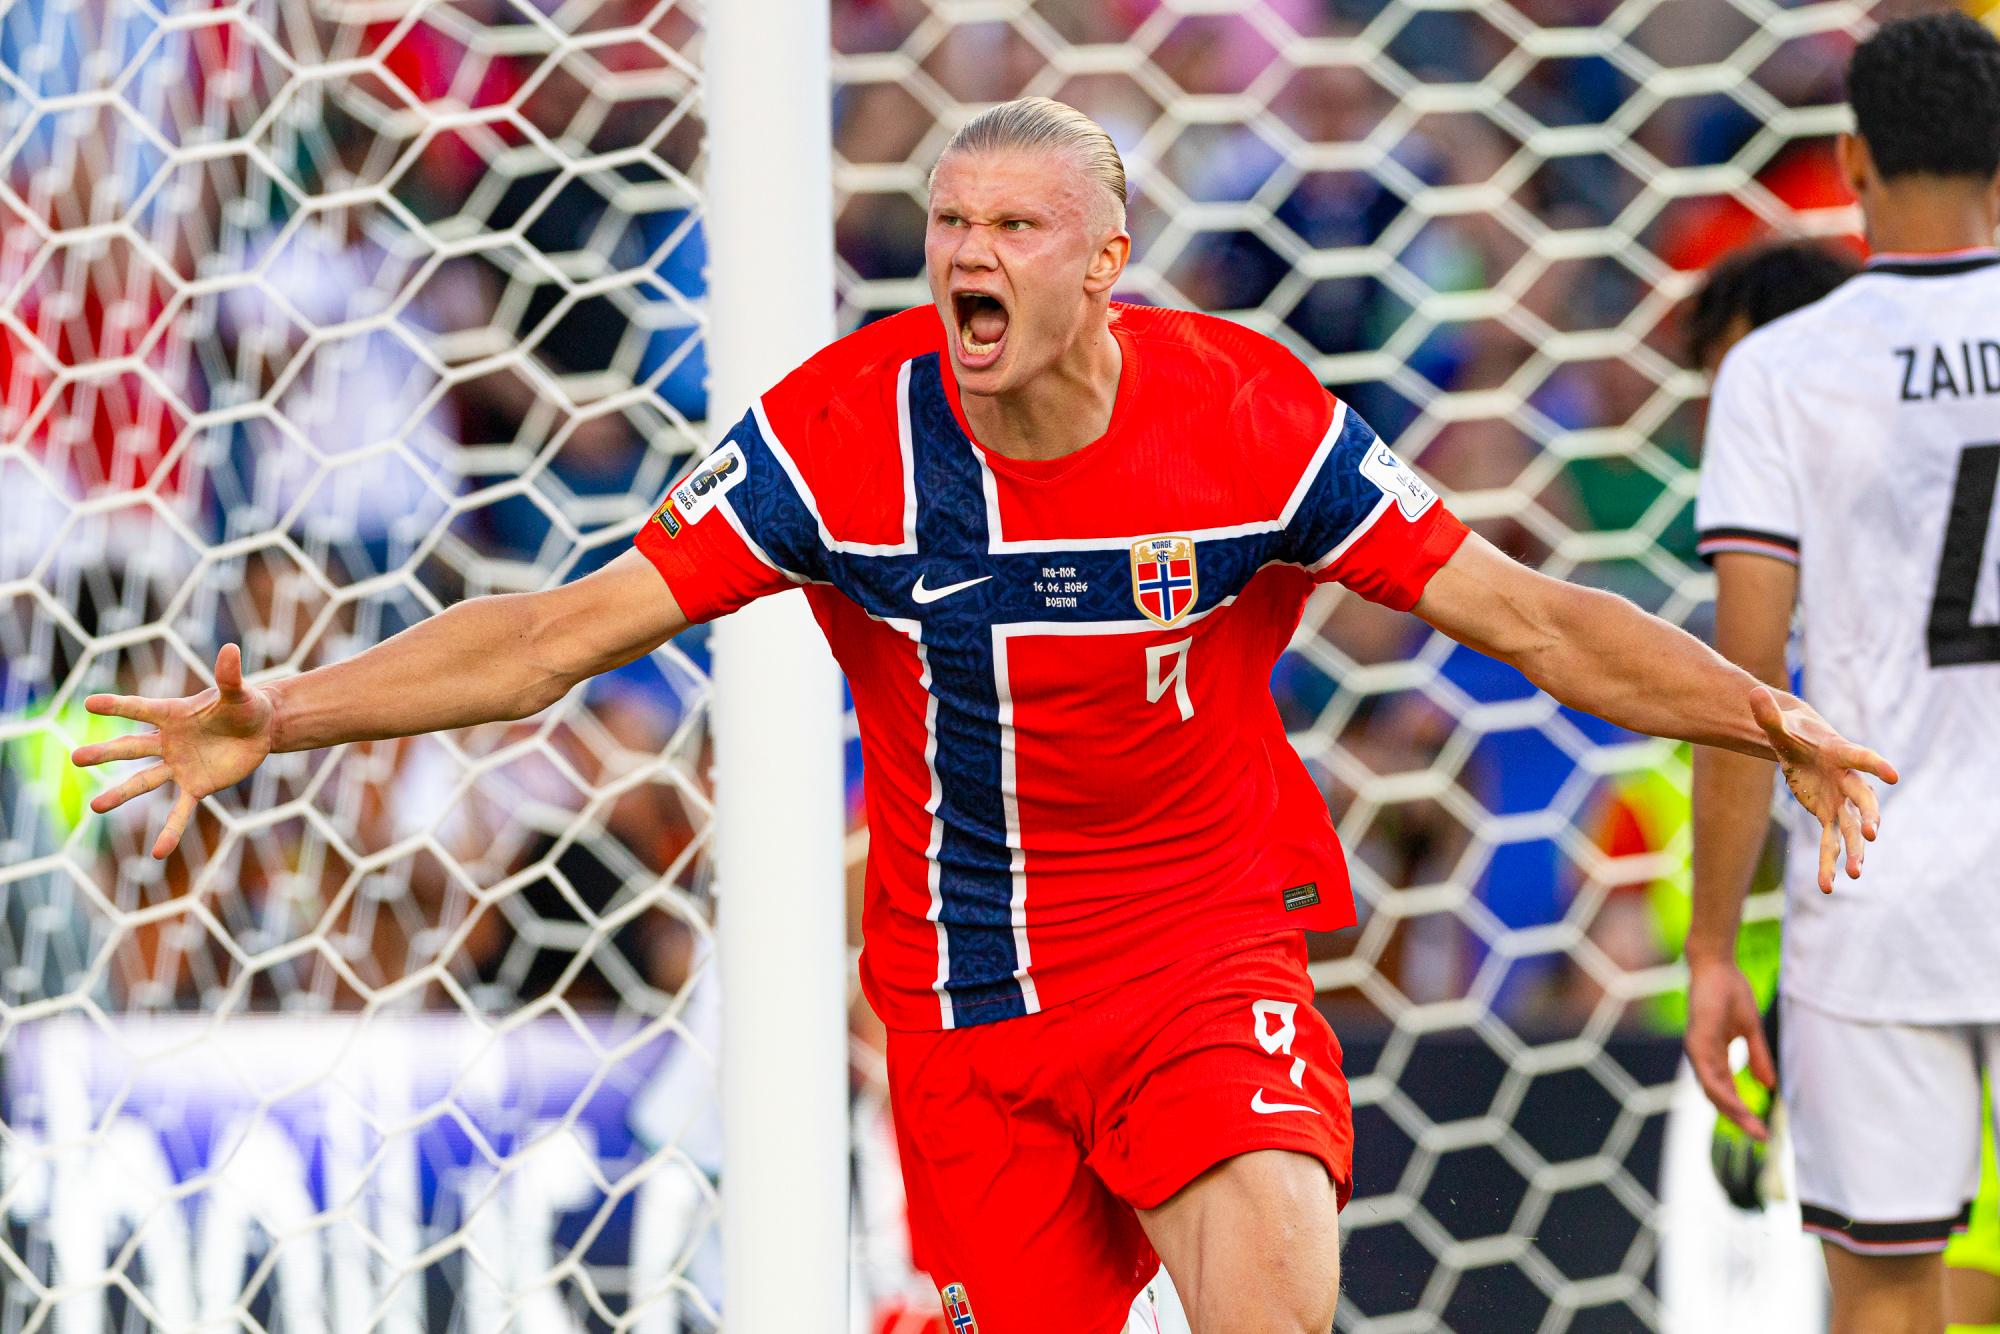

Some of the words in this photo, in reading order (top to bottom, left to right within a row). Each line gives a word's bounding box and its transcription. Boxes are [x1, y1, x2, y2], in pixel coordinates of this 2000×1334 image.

[1892, 340, 2000, 401] ZAID
[677, 490, 693, 510] 2026
[663, 511, 679, 528] DEBUT
[1151, 540, 1172, 549] NORGE
[1042, 567, 1076, 578] IRQ-NOR
[1045, 596, 1077, 608] BOSTON
[1145, 636, 1194, 722] 9
[1252, 999, 1306, 1089] 9
